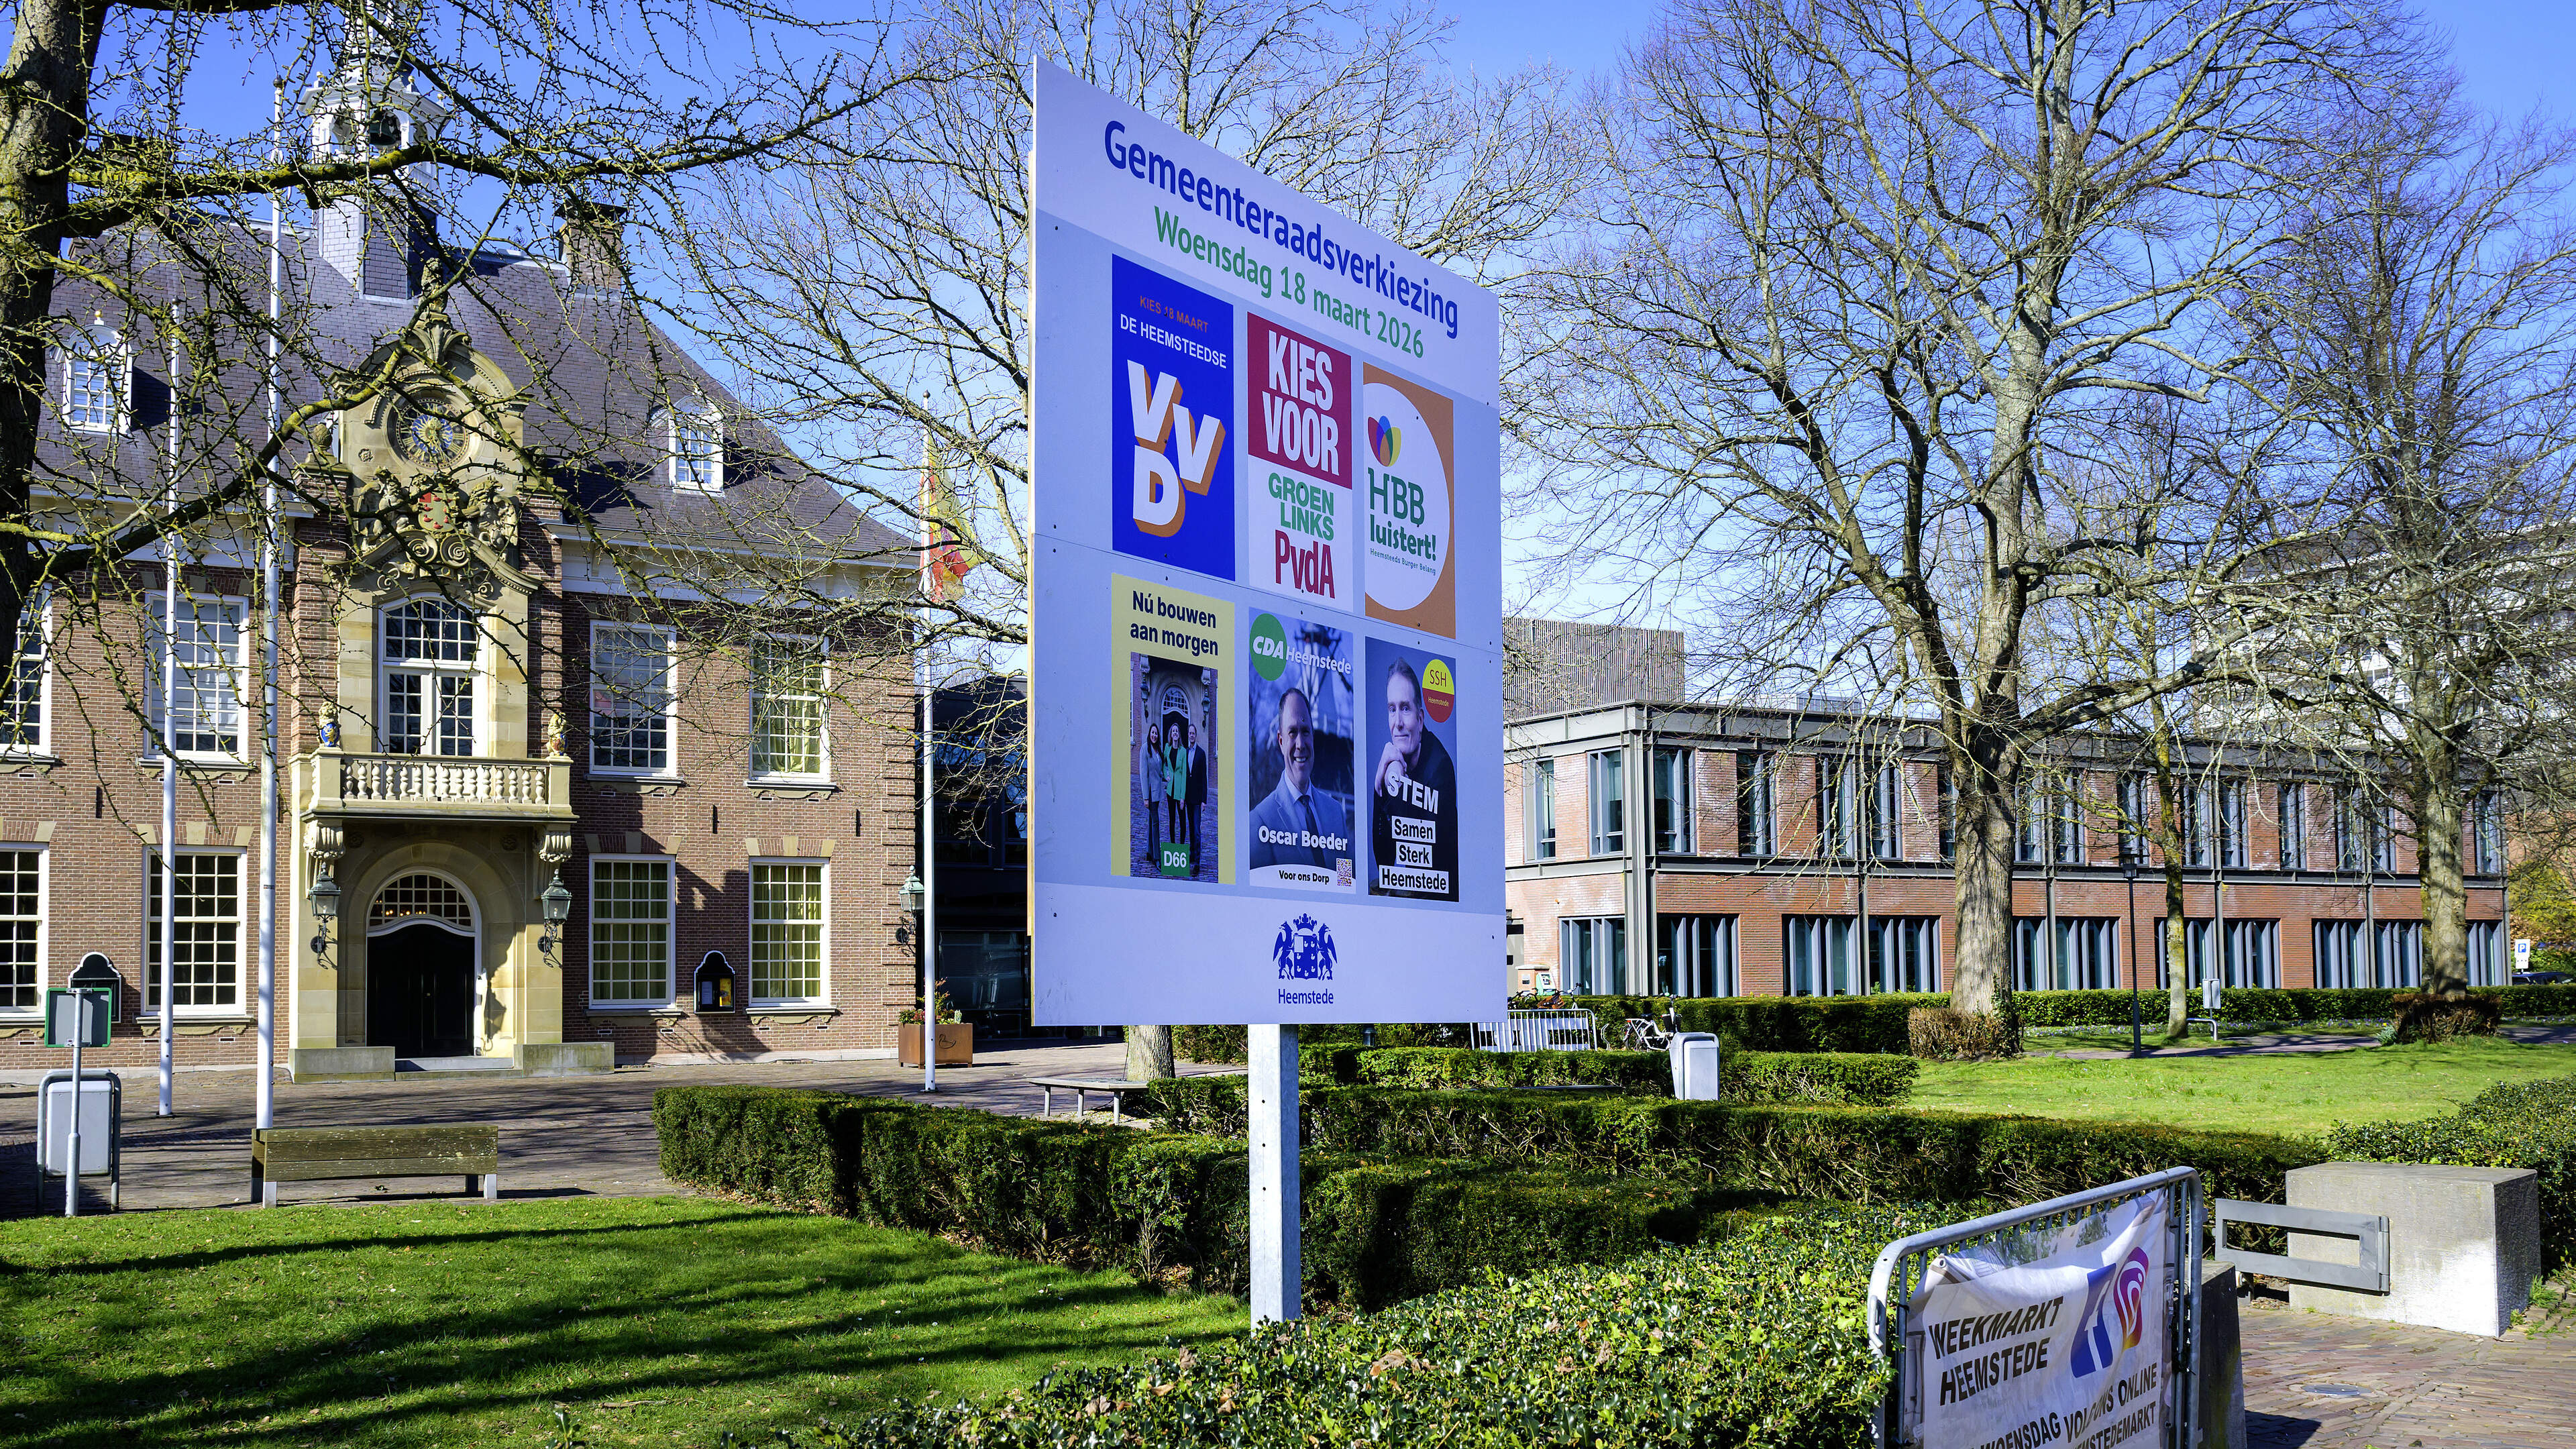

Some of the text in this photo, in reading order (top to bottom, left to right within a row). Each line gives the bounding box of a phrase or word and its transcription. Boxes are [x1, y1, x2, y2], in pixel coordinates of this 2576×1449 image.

[1105, 121, 1458, 339] Gemeenteraadsverkiezing
[1155, 205, 1424, 358] Woensdag 18 maart 2026
[1140, 295, 1209, 333] KIES 18 MAART
[1120, 313, 1227, 369] DE HEEMSTEEDSE
[1269, 329, 1334, 411] KIES
[1262, 391, 1340, 476] VOOR
[1268, 472, 1334, 517] GROEN
[1367, 467, 1425, 525] HBB
[1280, 502, 1334, 541] LINKS
[1370, 514, 1436, 561] luistert!
[1275, 529, 1336, 599] PvdA
[1370, 547, 1436, 576] Heemsteeds Burger Belang
[1132, 590, 1216, 629] Nú bouwen
[1130, 623, 1218, 657] aan morgen
[1252, 636, 1352, 674] CDA Heemstede
[1430, 669, 1447, 687] SSH
[1428, 696, 1449, 706] Heemstede
[1387, 773, 1439, 814] STEM
[1258, 825, 1348, 851] Oscar Boeder
[1394, 818, 1433, 840] Samen
[1163, 850, 1187, 868] D66
[1399, 845, 1430, 864] Sterk
[1279, 870, 1330, 885] Voor ons Dorp
[1382, 867, 1446, 890] Heemstede
[1278, 988, 1334, 1004] Heemstede
[1928, 1295, 2063, 1360] WEEKMARKT
[1939, 1337, 2051, 1406] HEEMSTEDE
[2118, 1362, 2157, 1406] ONLINE
